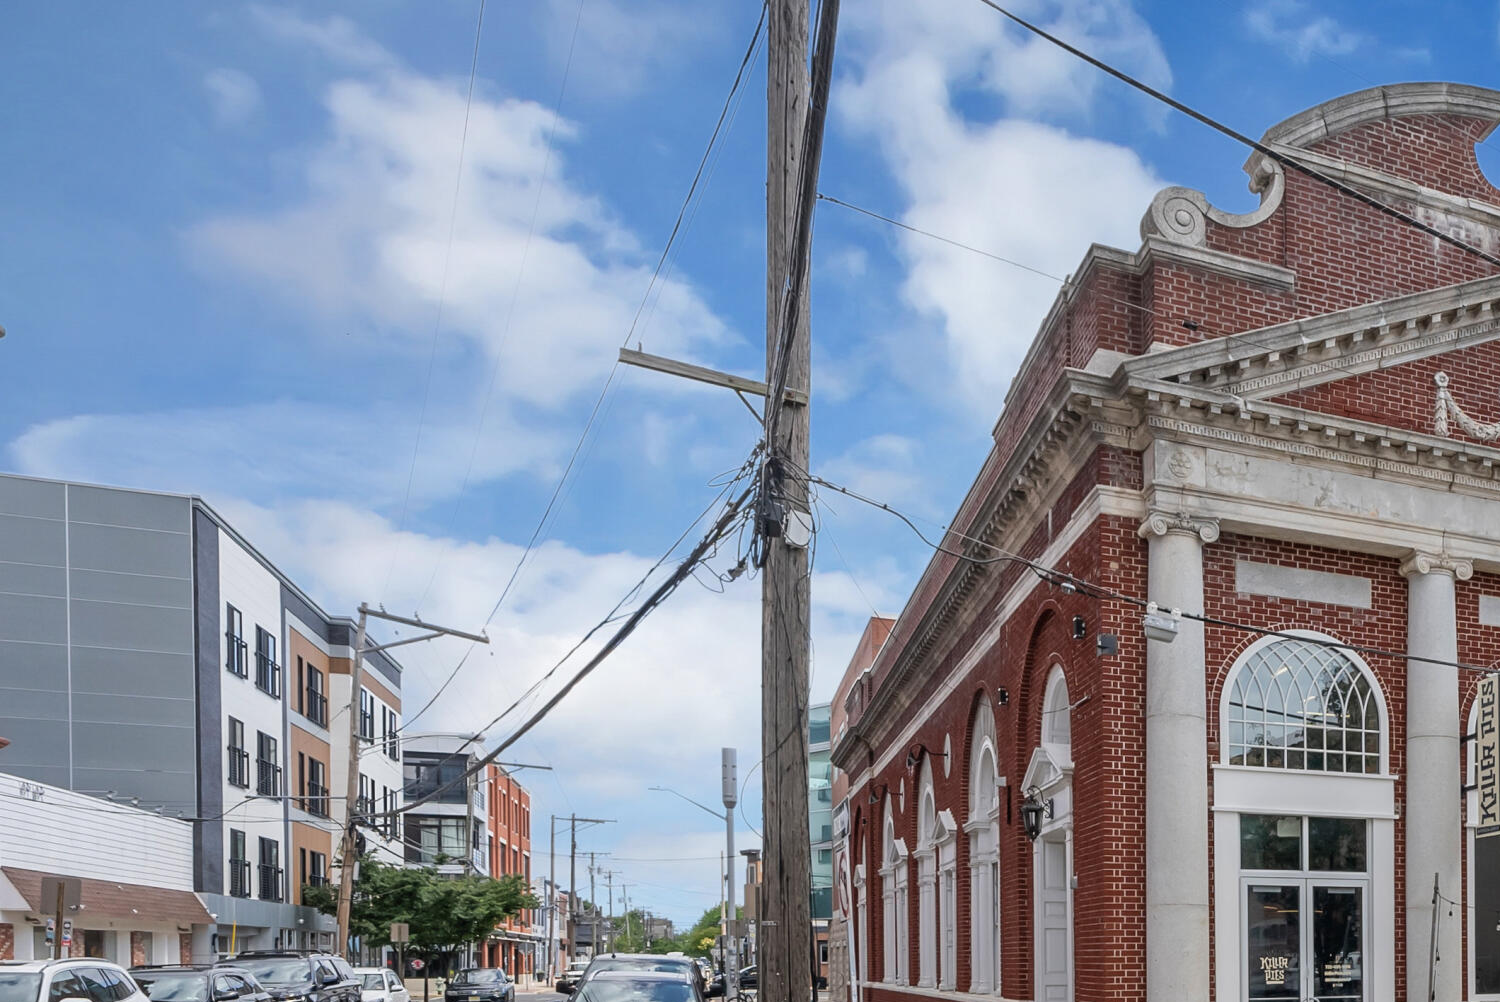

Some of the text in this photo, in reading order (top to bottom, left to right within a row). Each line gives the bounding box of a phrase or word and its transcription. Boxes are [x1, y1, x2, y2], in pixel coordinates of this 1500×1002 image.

[1481, 680, 1495, 739] PIES
[1481, 742, 1497, 825] KILLER
[1260, 957, 1288, 969] KILLER
[1265, 970, 1284, 980] PIES
